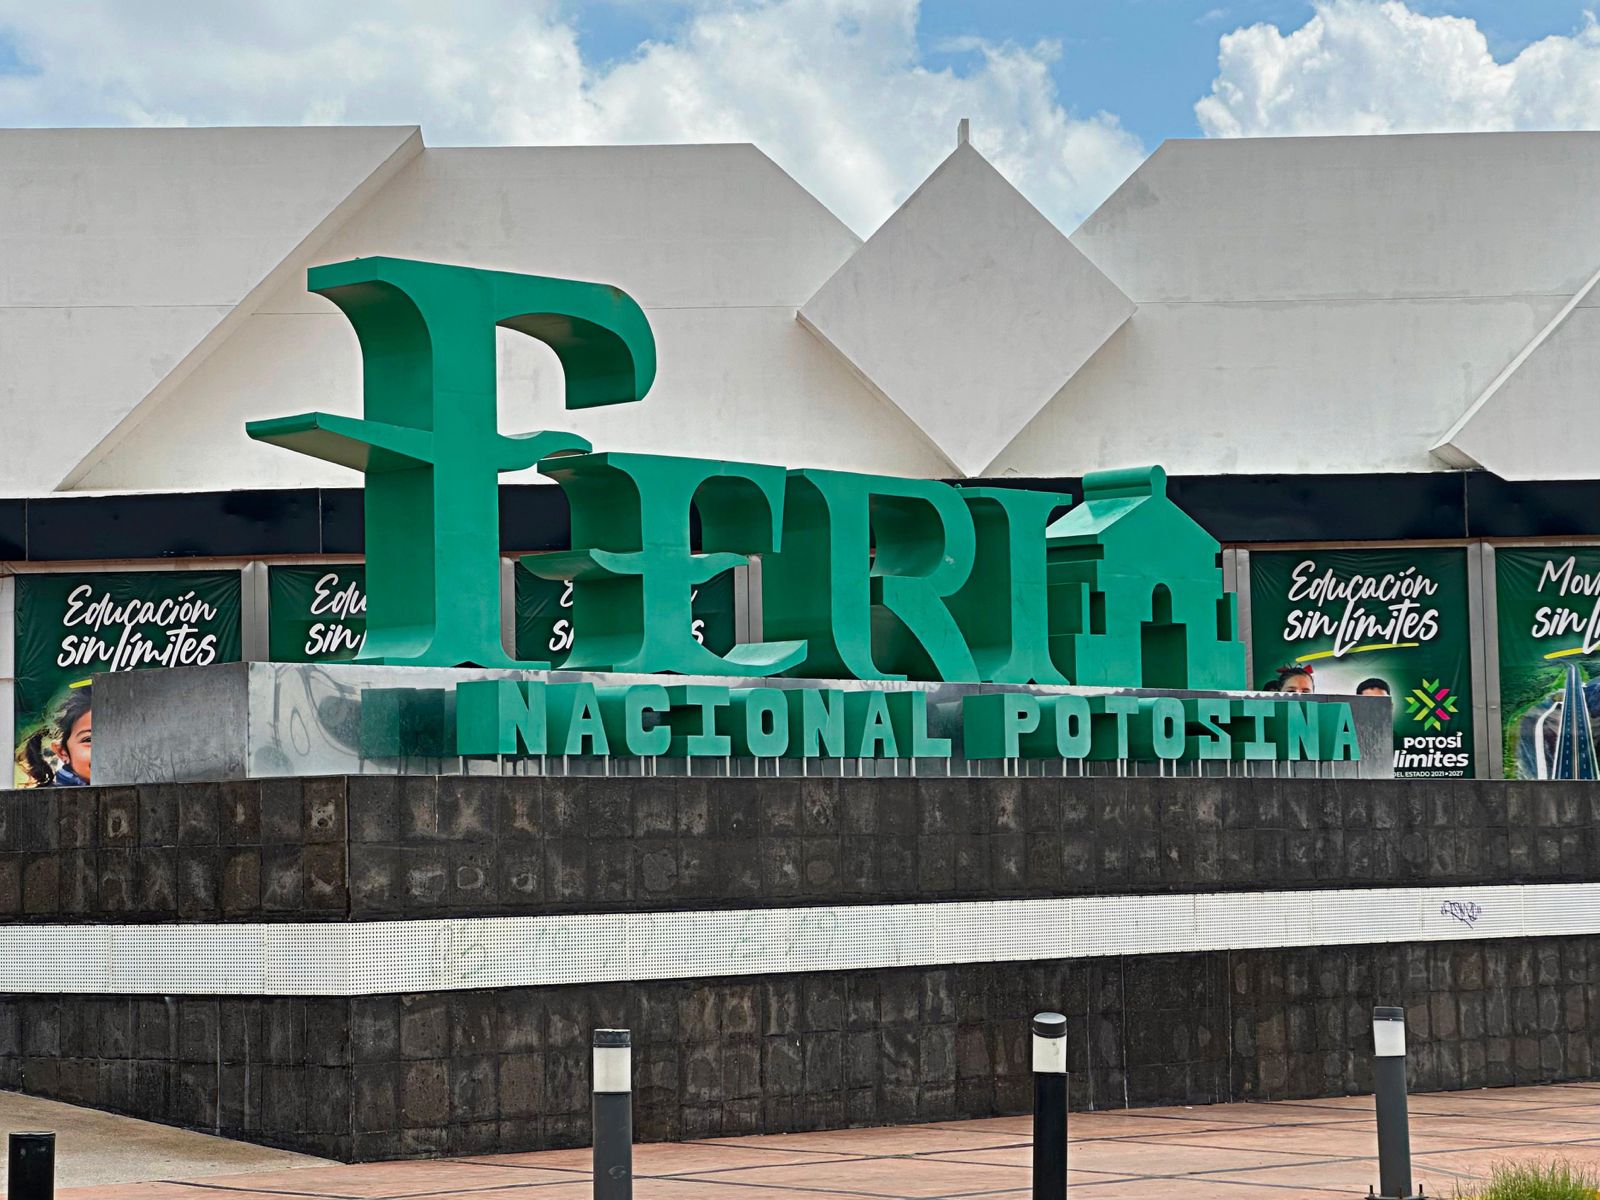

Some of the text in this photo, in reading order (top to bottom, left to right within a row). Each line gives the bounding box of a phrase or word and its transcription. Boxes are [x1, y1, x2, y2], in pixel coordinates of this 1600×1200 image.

[1288, 560, 1438, 607] Educación
[63, 585, 217, 632] Educación
[1283, 598, 1439, 657] sin límites
[1532, 607, 1587, 638] sin
[57, 623, 217, 672] sin límites
[305, 623, 360, 655] sin
[457, 680, 1361, 761] NACIONAL POTOSINA
[1404, 732, 1462, 748] POTOSÍ
[1393, 749, 1469, 768] límites
